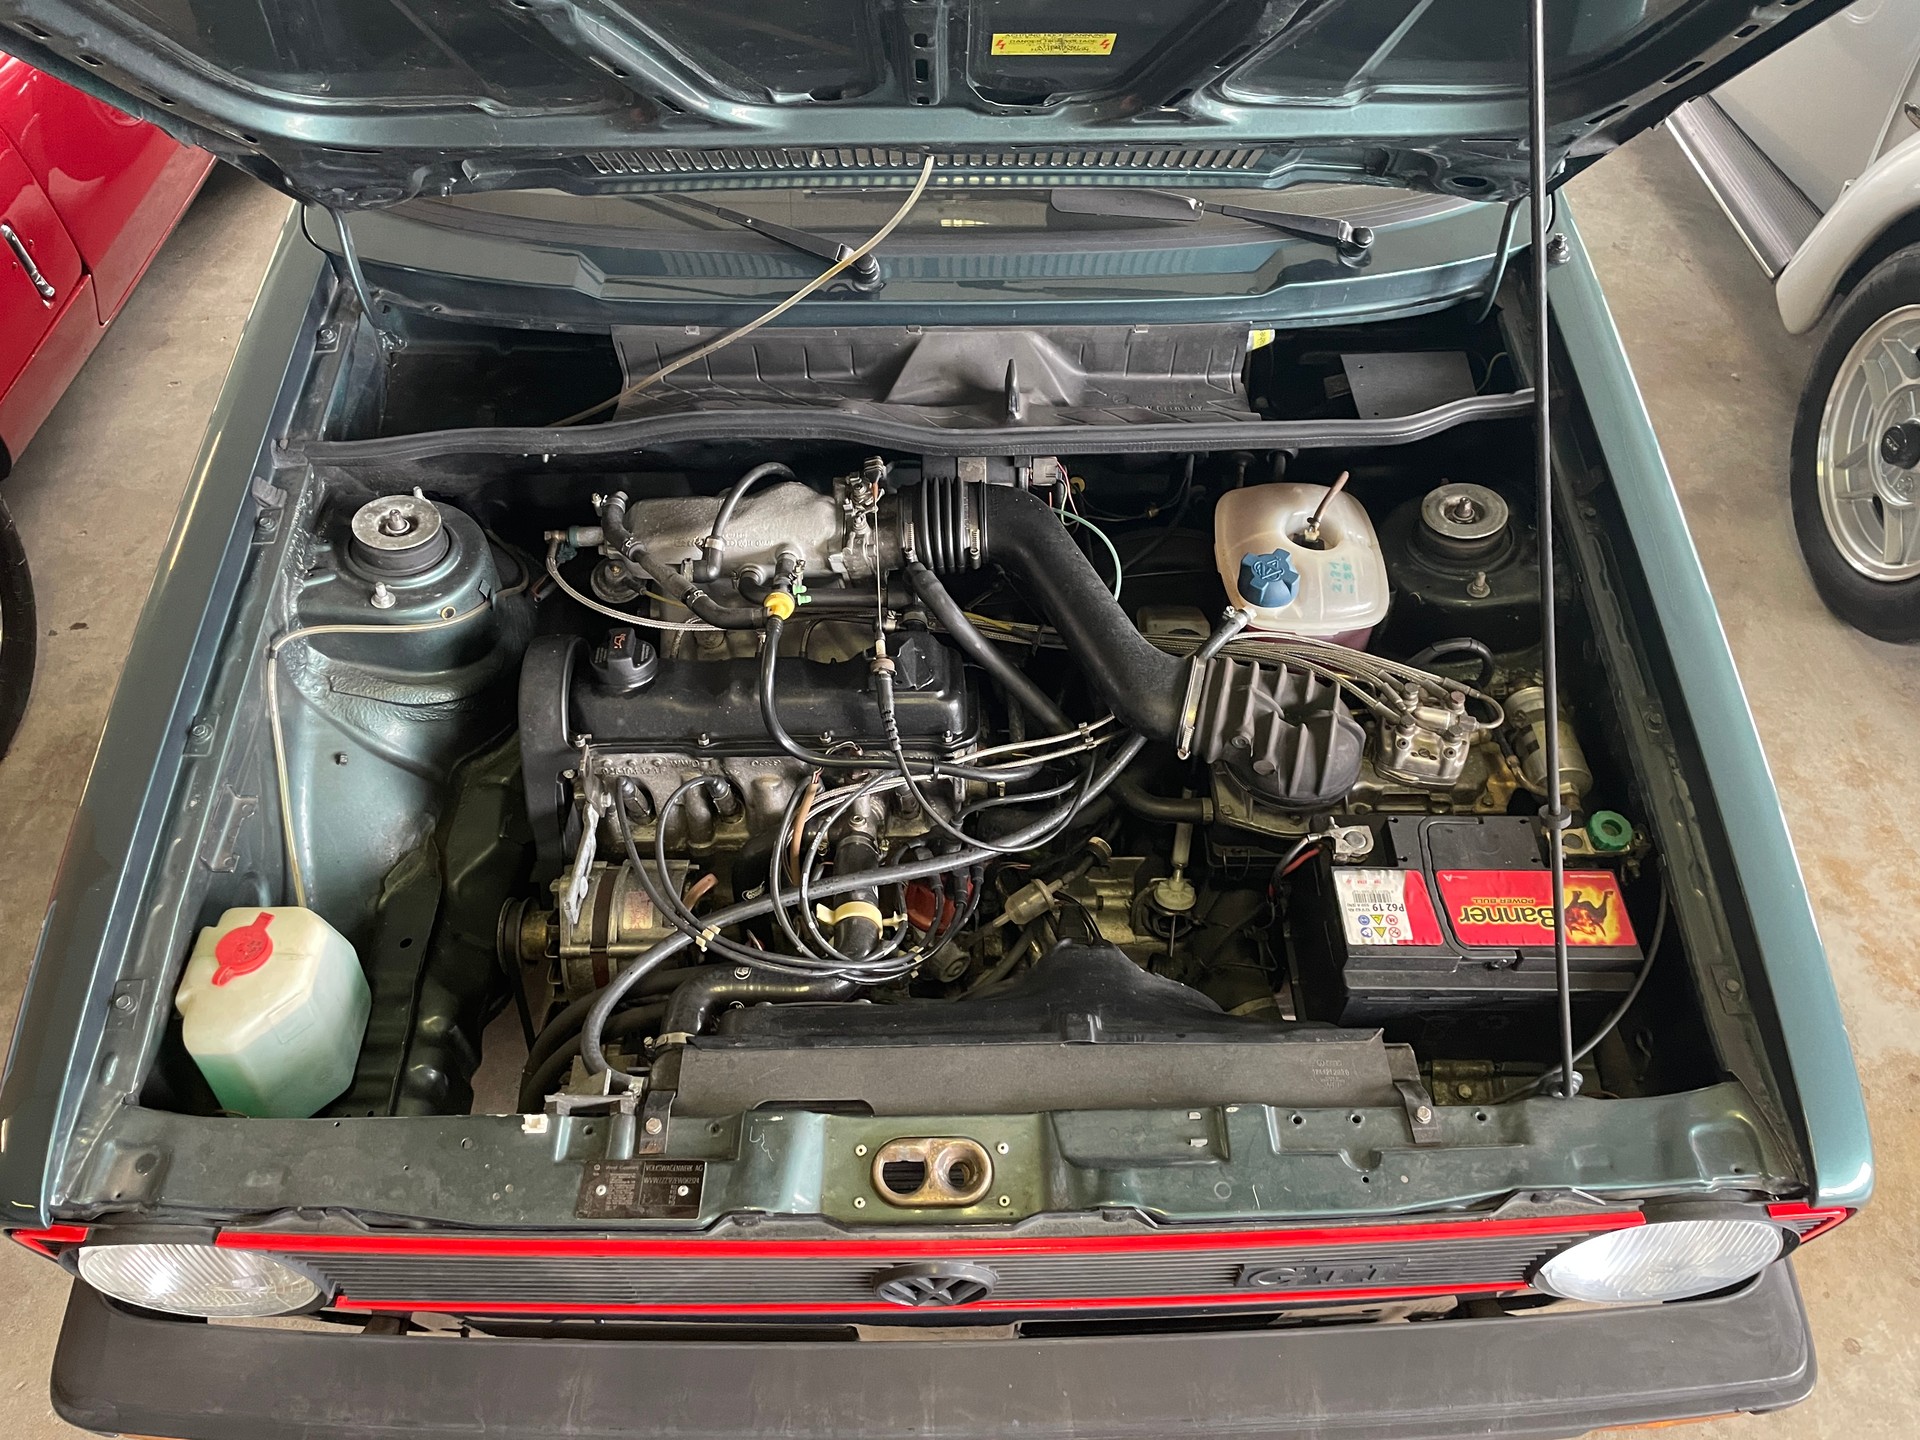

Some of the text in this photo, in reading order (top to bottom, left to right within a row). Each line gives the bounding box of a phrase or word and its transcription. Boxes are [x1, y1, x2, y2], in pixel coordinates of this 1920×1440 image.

[1372, 903, 1405, 912] P62 19
[1459, 906, 1555, 928] Banner
[1248, 1264, 1395, 1286] GTI
